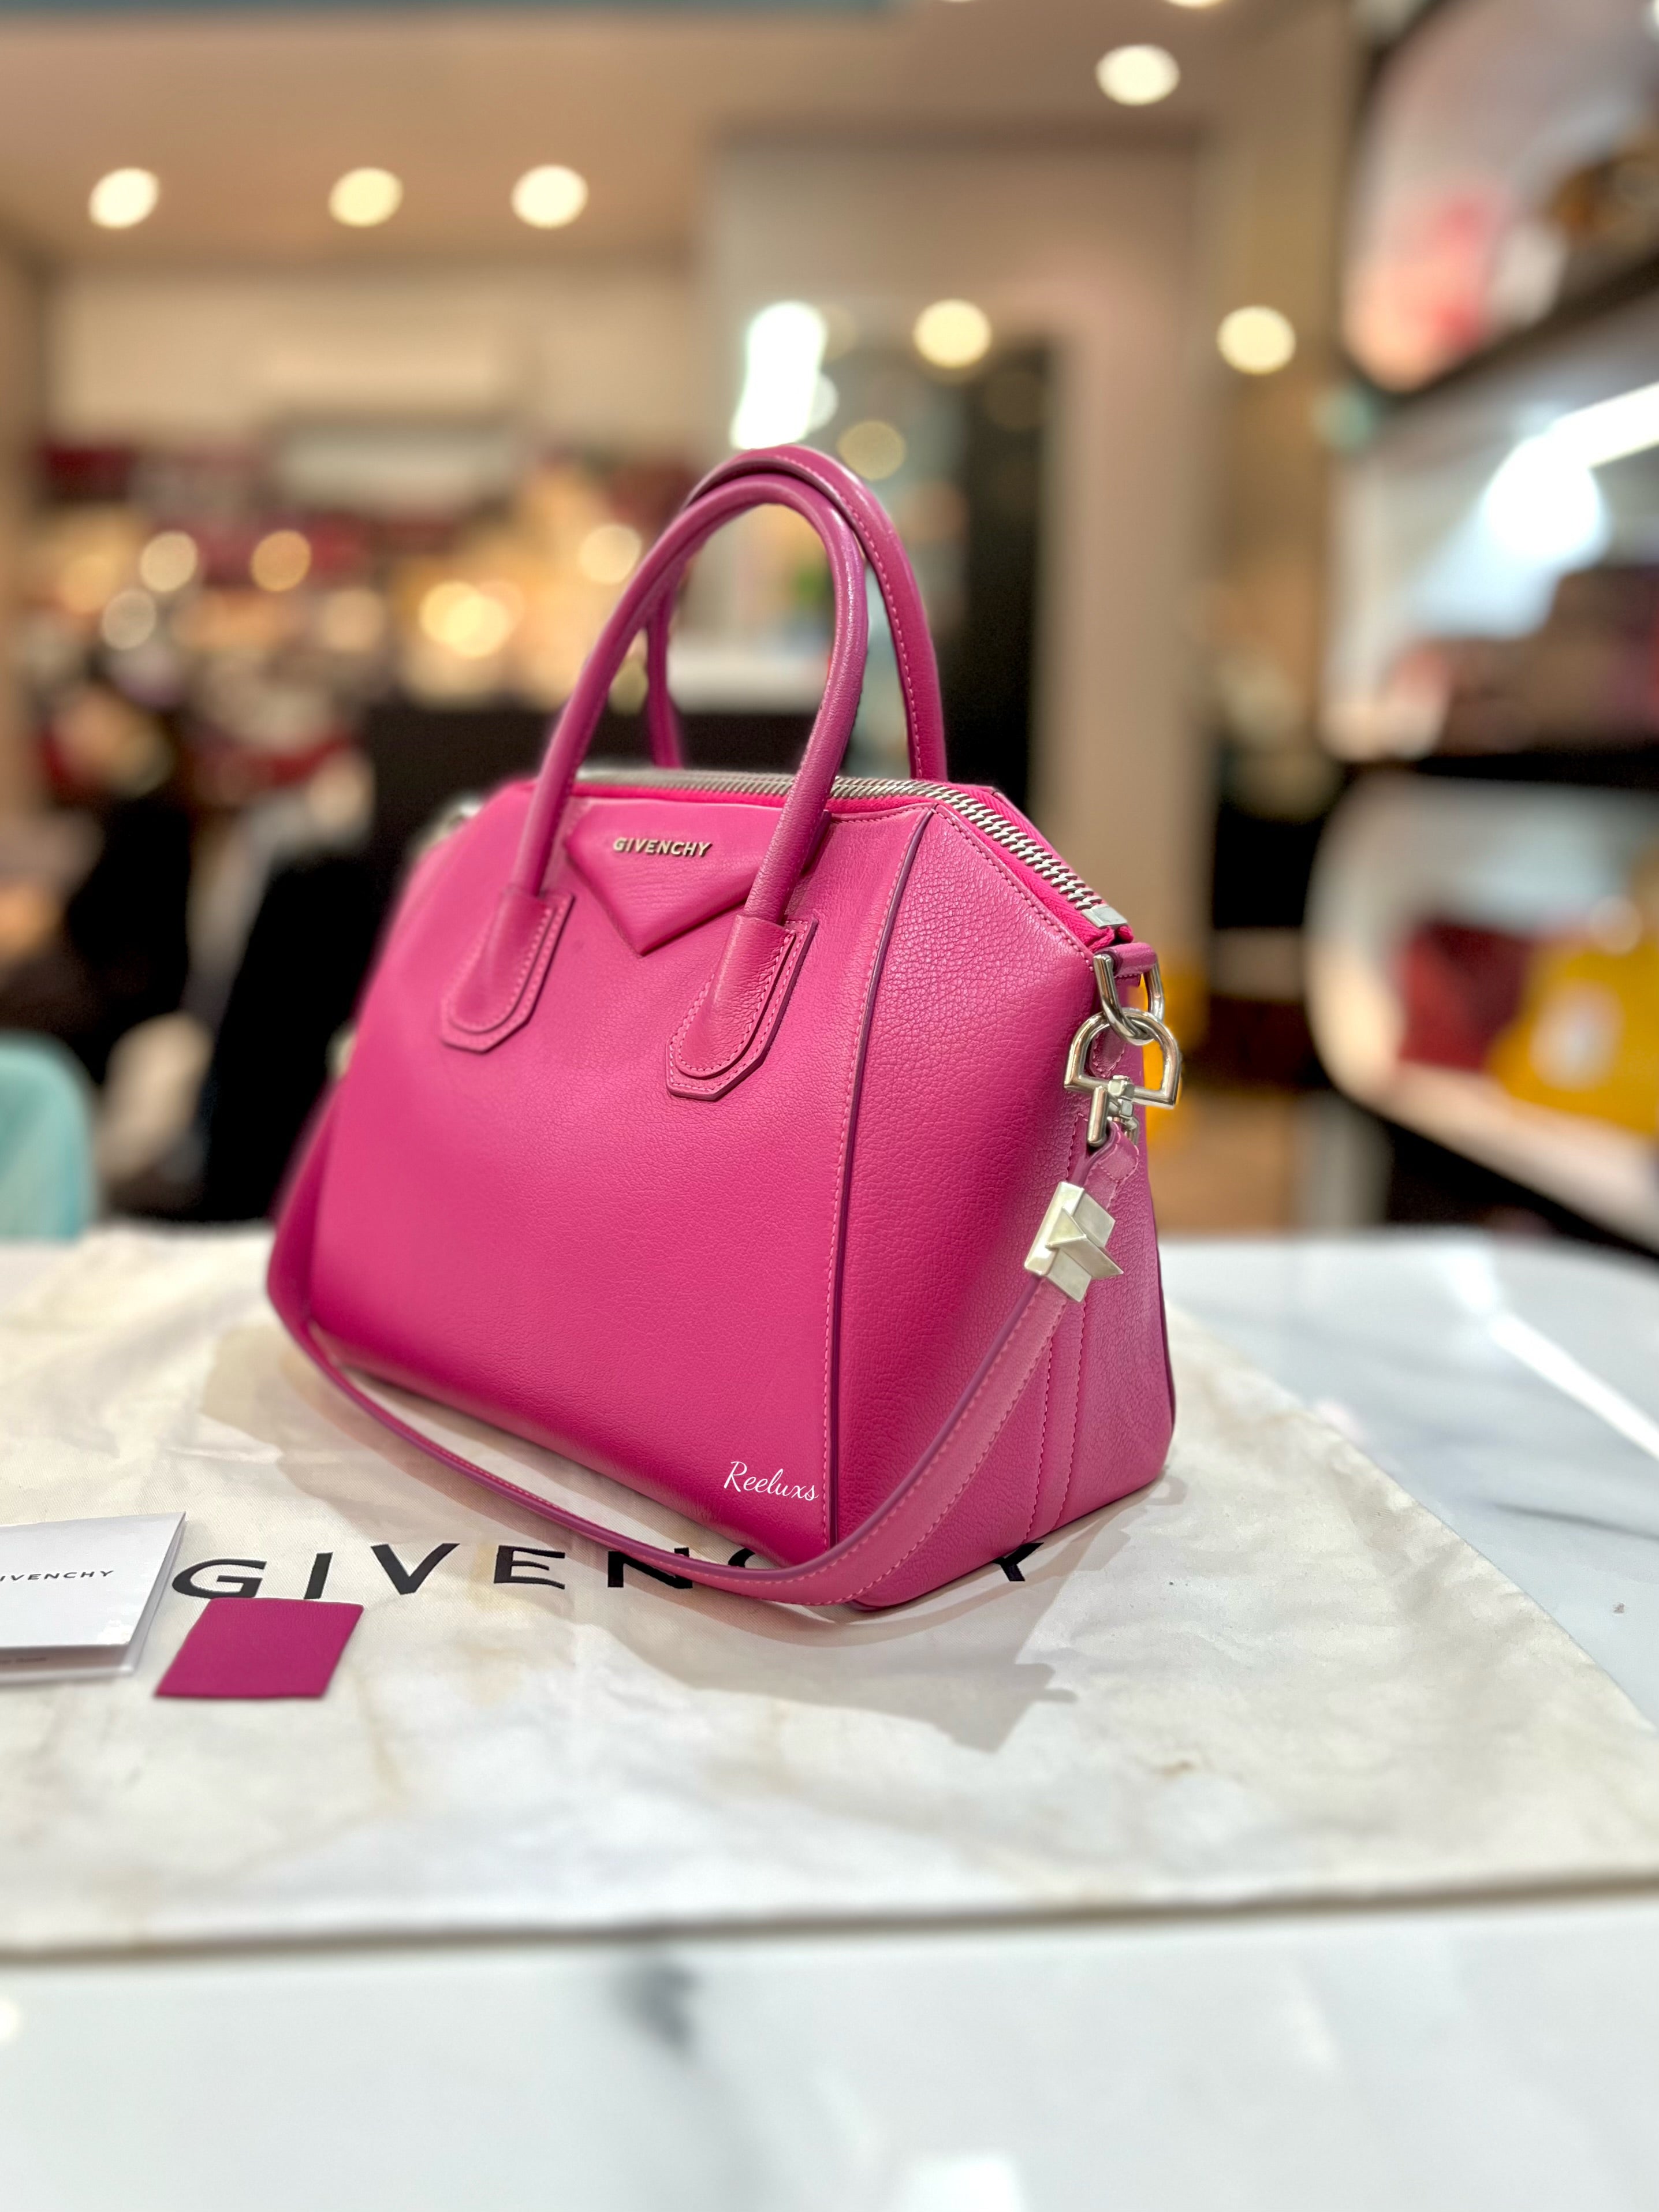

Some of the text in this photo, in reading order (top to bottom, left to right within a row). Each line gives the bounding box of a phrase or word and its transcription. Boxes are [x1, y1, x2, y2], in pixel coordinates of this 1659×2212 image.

[613, 837, 712, 856] GIVENCHY
[0, 1570, 114, 1582] IVENCHY
[172, 1543, 1044, 1600] GIVENY
